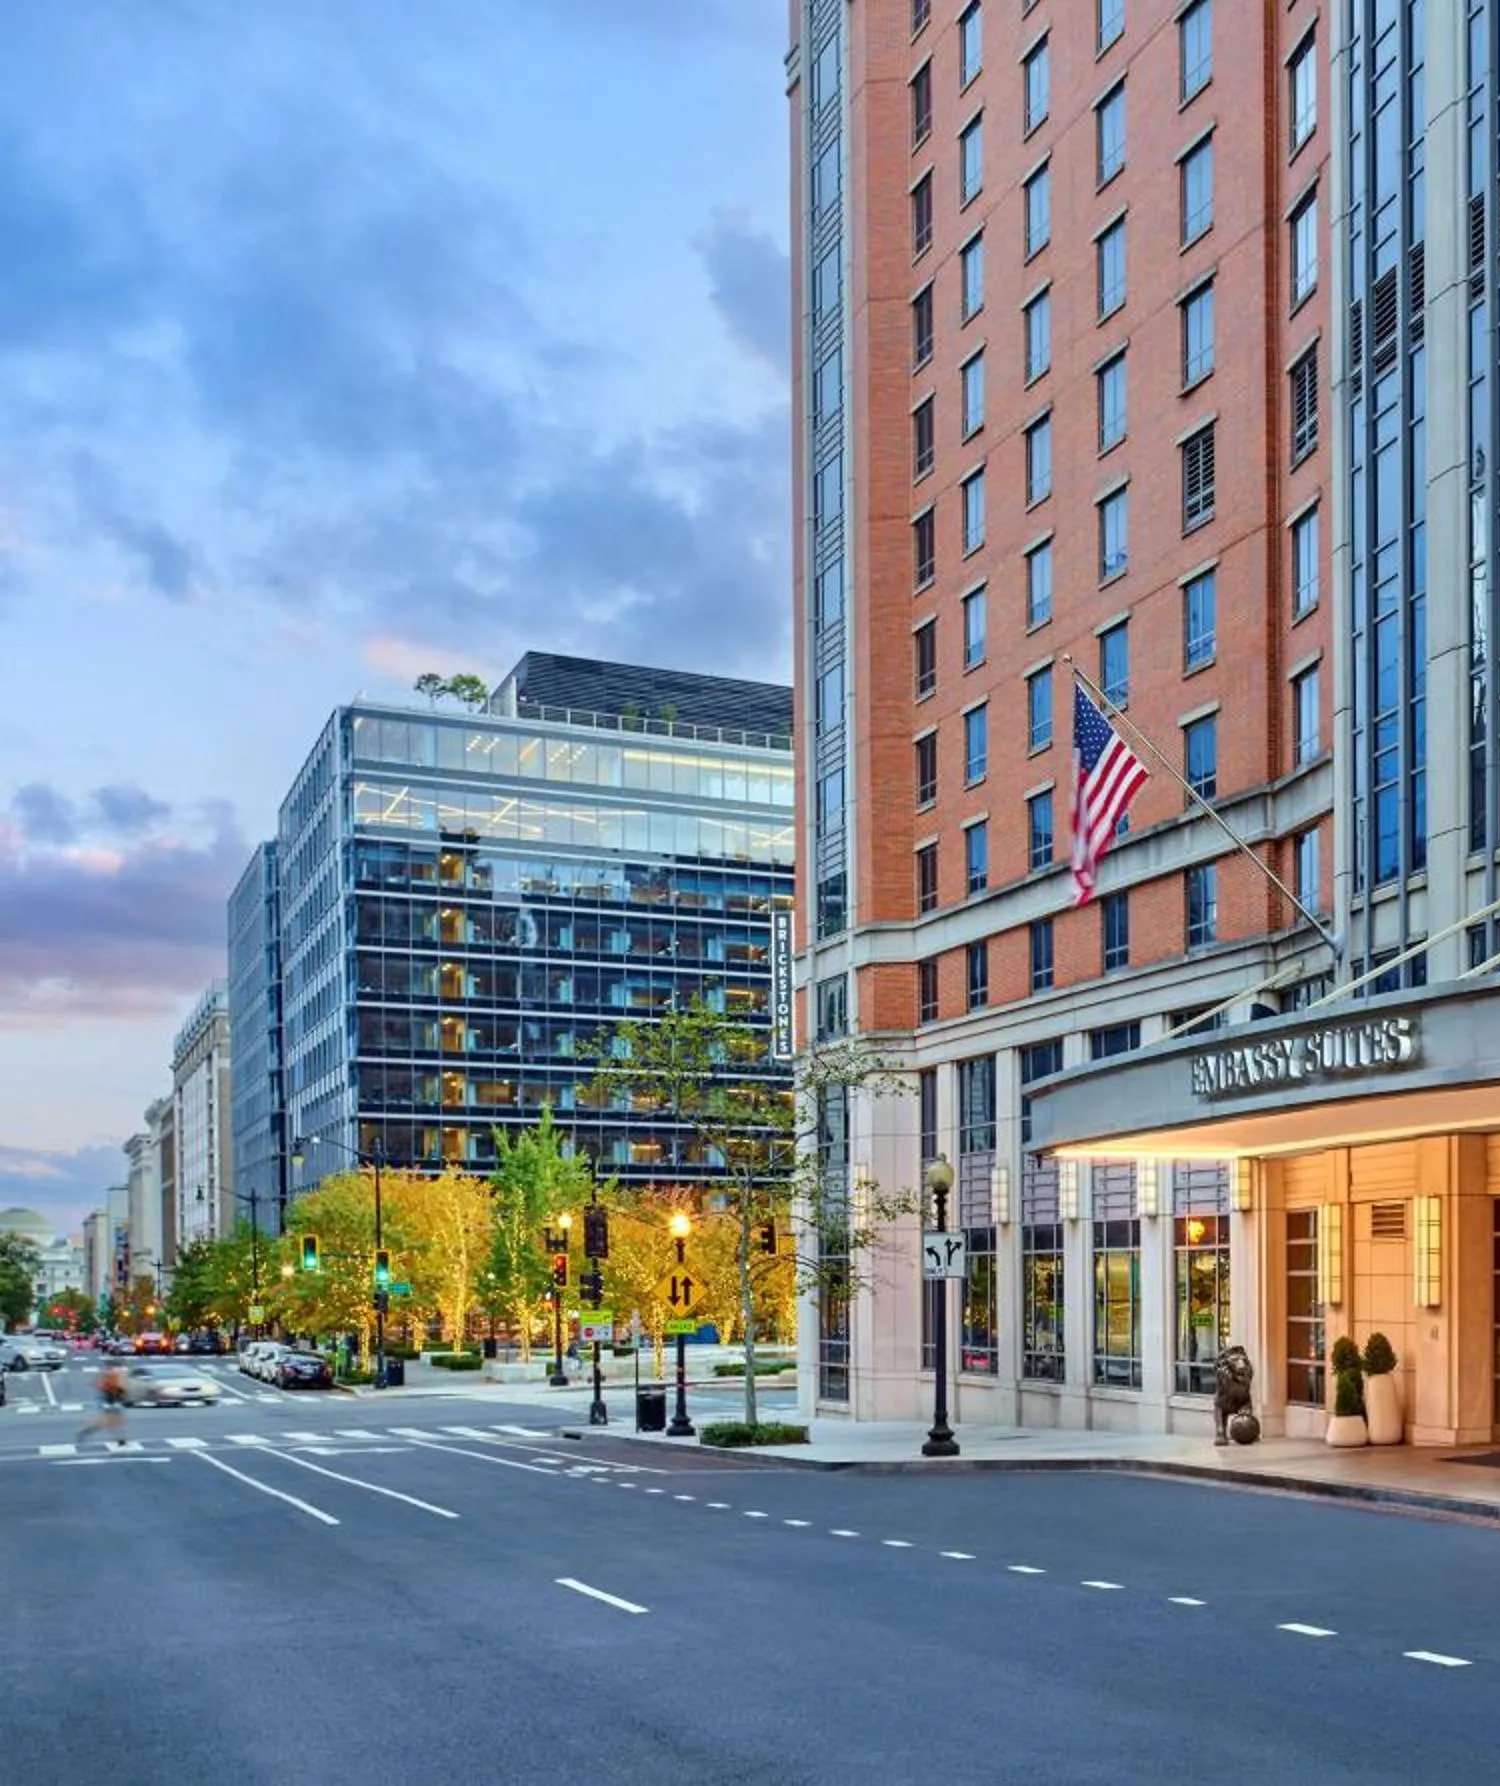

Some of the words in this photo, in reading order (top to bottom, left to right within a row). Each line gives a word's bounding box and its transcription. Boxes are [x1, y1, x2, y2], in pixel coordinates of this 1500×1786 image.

[777, 916, 789, 1053] BRICKSTONES
[1190, 1038, 1302, 1096] EMBASSY
[1305, 1018, 1414, 1073] SUITES
